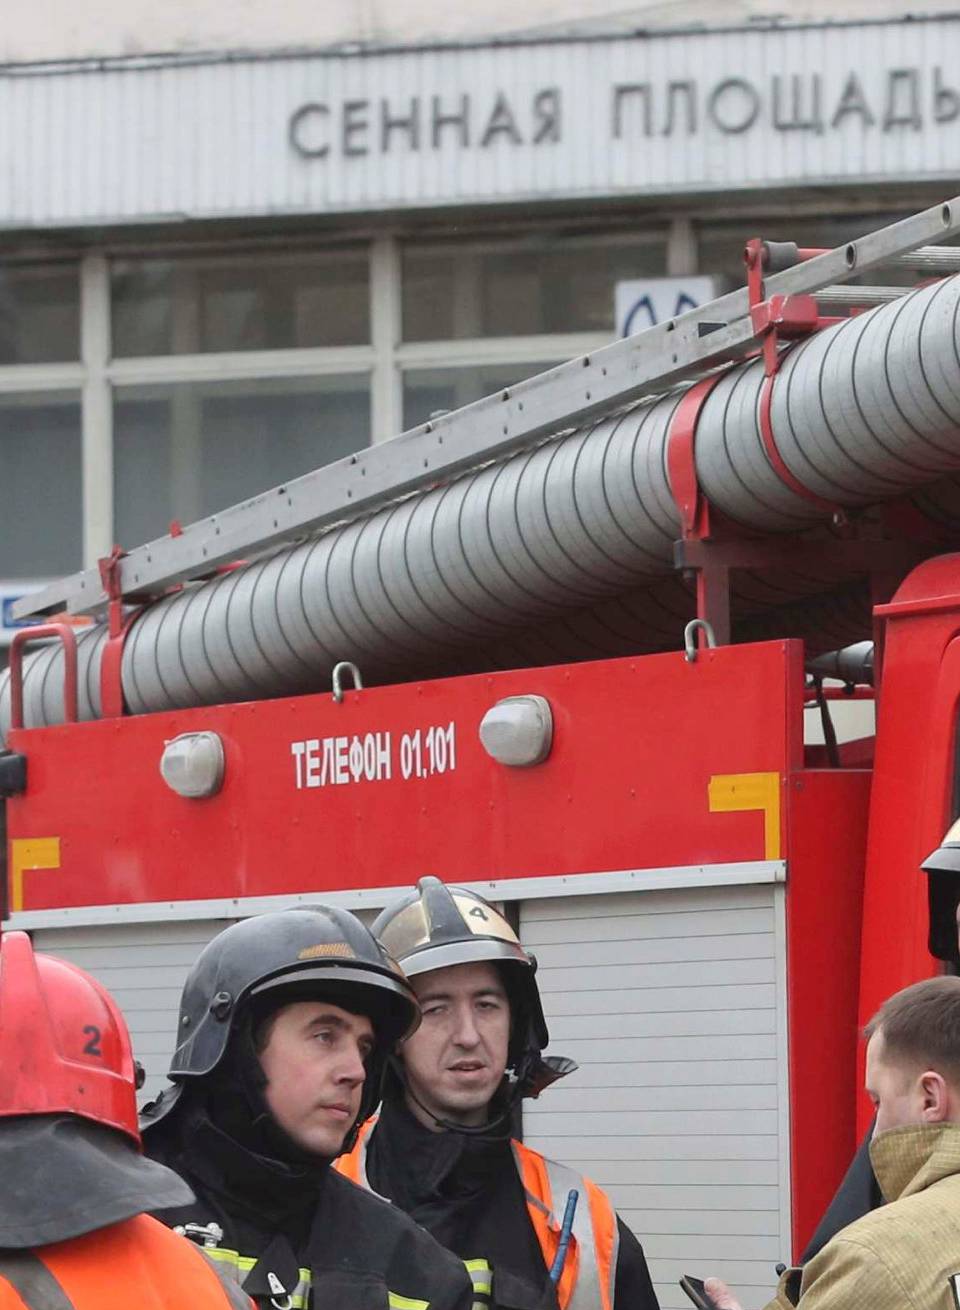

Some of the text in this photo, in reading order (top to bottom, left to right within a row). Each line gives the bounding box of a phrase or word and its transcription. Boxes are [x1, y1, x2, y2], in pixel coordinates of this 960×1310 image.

[288, 87, 562, 160] СЕННАЯ
[291, 731, 391, 789] ТЕЛЕФОН
[469, 906, 489, 921] 4
[82, 1025, 101, 1056] 2
